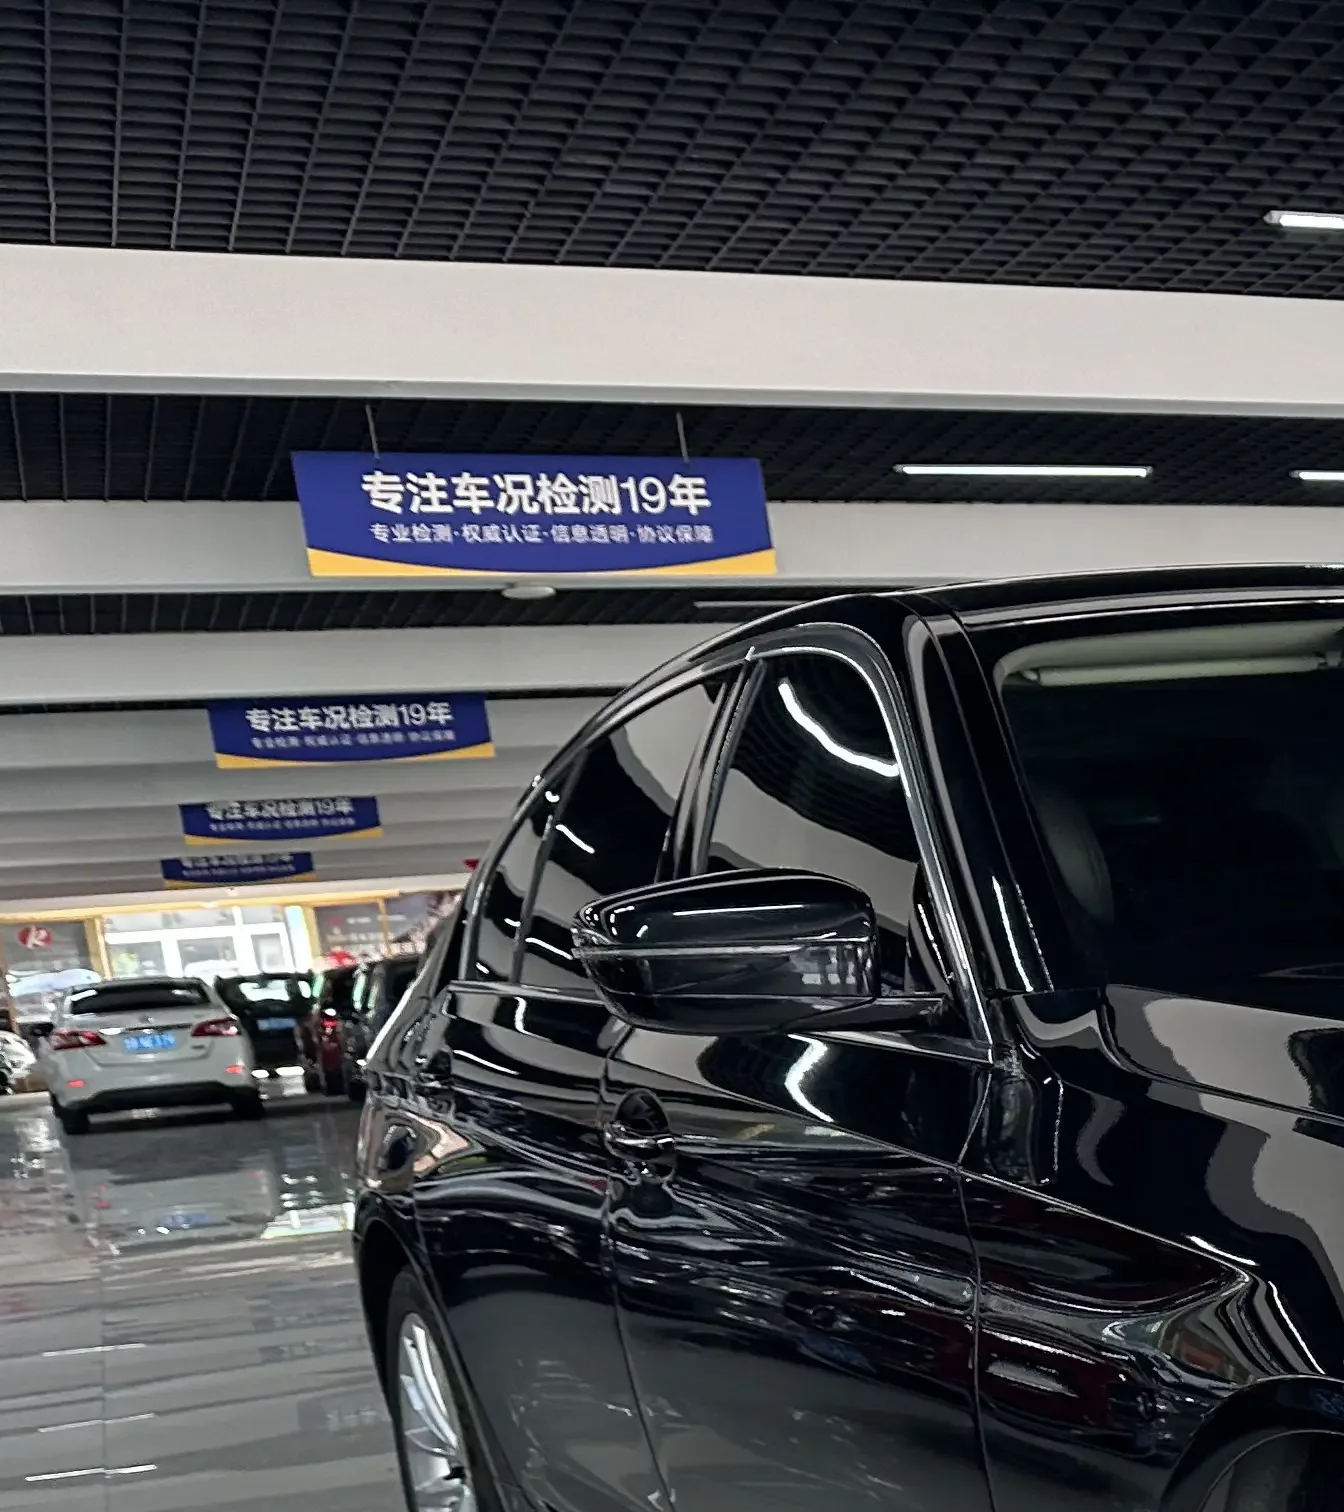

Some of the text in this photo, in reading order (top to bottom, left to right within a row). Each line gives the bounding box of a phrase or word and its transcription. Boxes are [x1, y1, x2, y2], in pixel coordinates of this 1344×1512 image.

[361, 471, 711, 515] 专注车况检测19年
[245, 701, 455, 734] 专注车况检测19年
